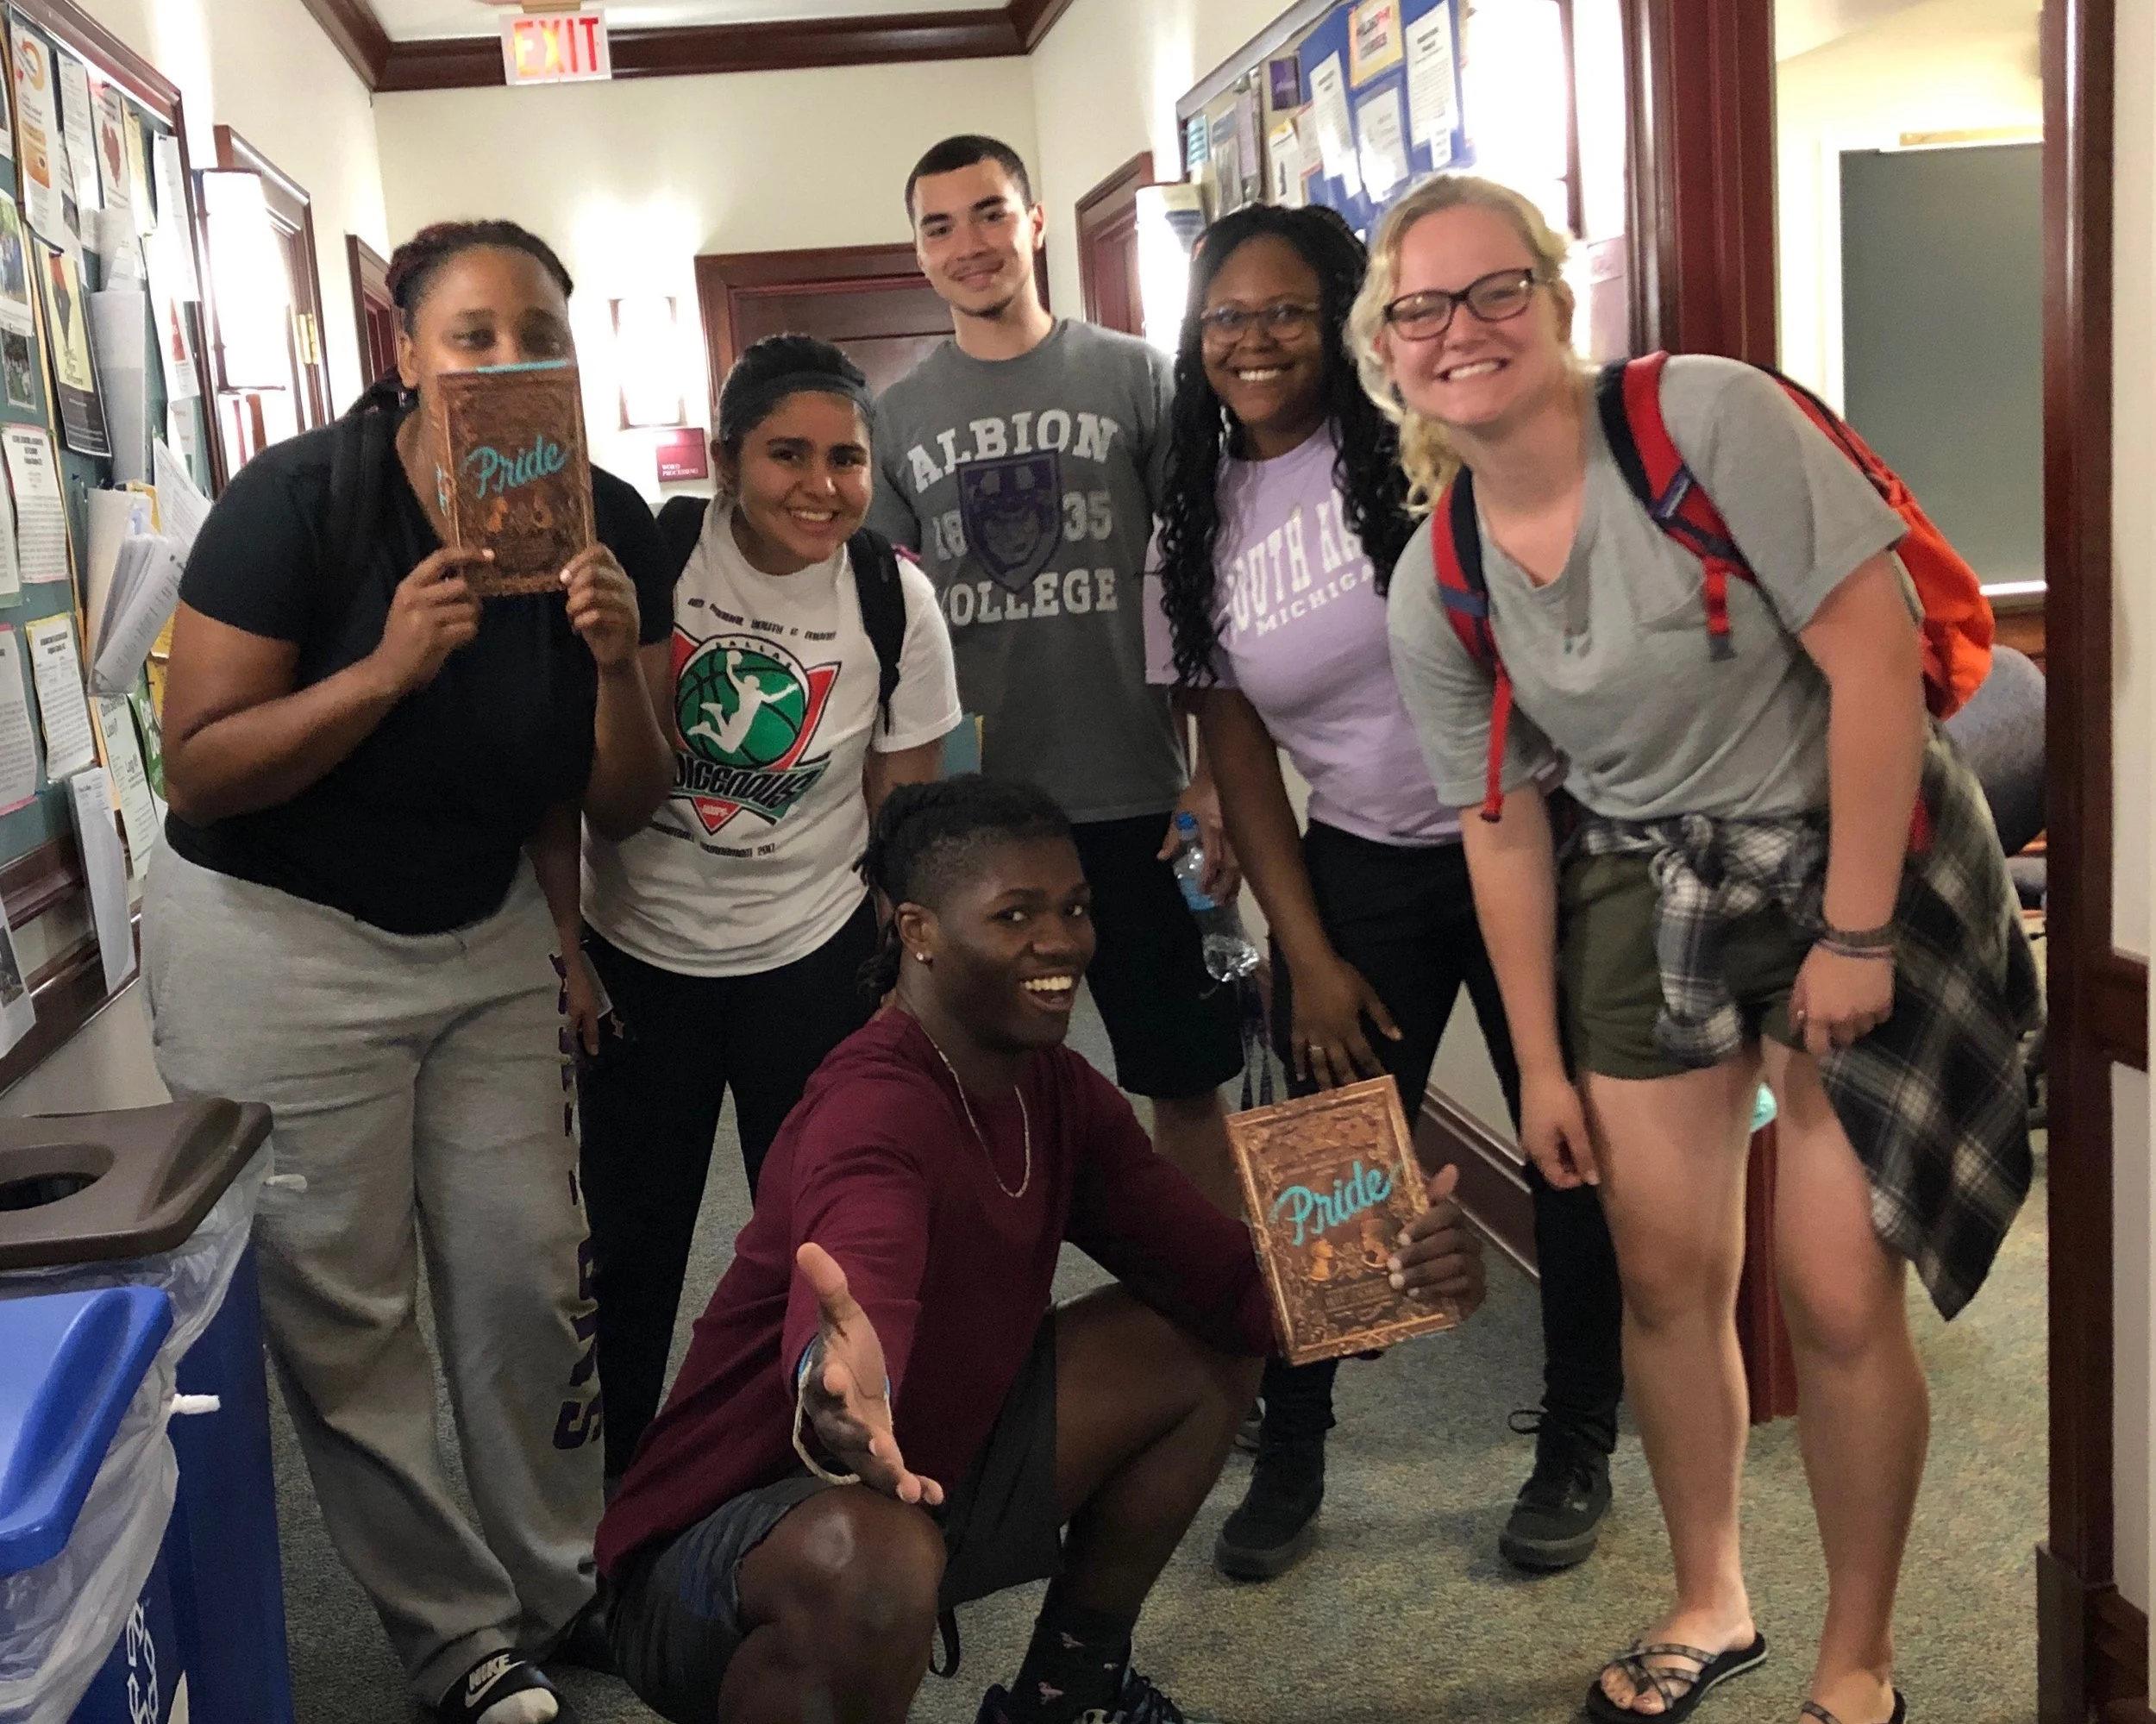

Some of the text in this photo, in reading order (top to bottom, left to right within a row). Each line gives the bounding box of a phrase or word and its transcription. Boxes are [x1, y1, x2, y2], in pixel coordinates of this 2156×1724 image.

[513, 17, 599, 77] EXIT
[460, 434, 569, 500] Pride
[907, 408, 1119, 494] ALBION
[1062, 489, 1113, 542] 35
[940, 567, 1119, 627] OLLEGE
[1256, 564, 1375, 637] MICHIGA
[1268, 1158, 1403, 1247] Pride
[468, 1653, 511, 1691] NIKE
